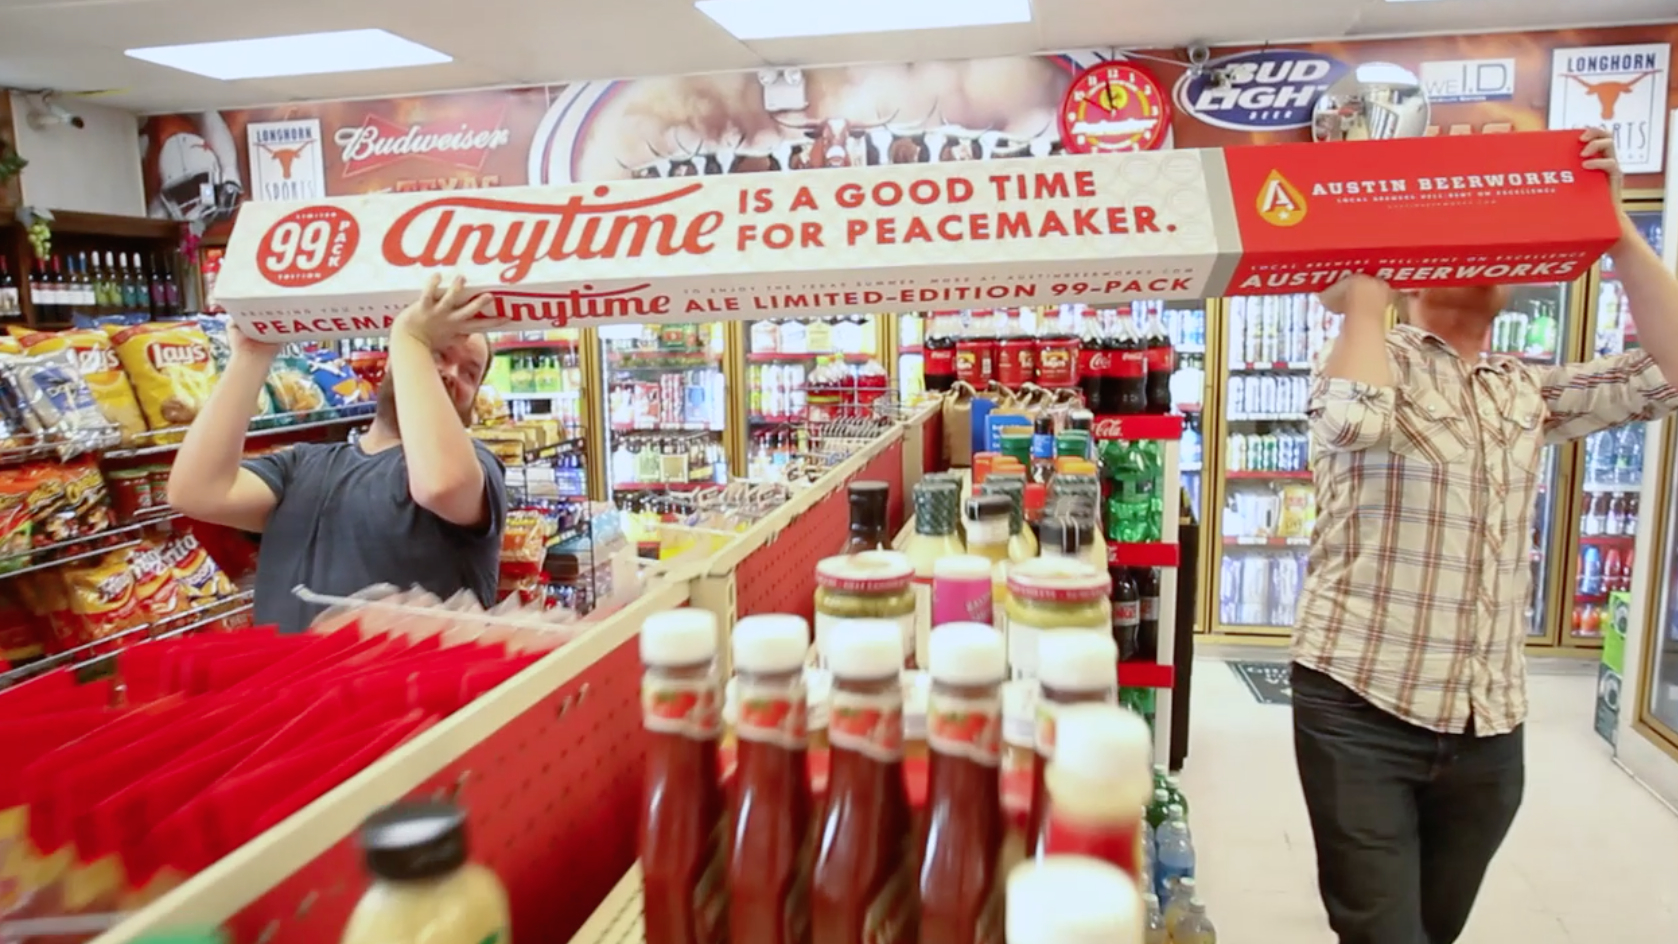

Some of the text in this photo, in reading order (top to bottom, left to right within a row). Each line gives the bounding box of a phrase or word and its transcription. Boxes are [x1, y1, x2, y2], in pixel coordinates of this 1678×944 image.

[1226, 60, 1330, 84] BUD
[1567, 53, 1657, 72] LONGHORN
[1426, 64, 1511, 95] WE I.D.
[256, 126, 312, 143] LONGHORN
[334, 123, 508, 163] Budweiser
[738, 170, 1097, 215] IS A GOOD TIME
[1311, 170, 1575, 196] AUSTIN BEERWORKS
[327, 220, 351, 268] PACK
[736, 205, 1178, 252] FOR PEACEMAKER.
[265, 220, 332, 272] 99
[1378, 261, 1578, 281] BEERWORKS
[251, 315, 395, 335] PEACEMA
[684, 297, 740, 313] ALE
[753, 284, 1037, 310] LIMITED-EDITION
[1050, 277, 1194, 297] 99-PACK
[152, 341, 207, 369] Lay's
